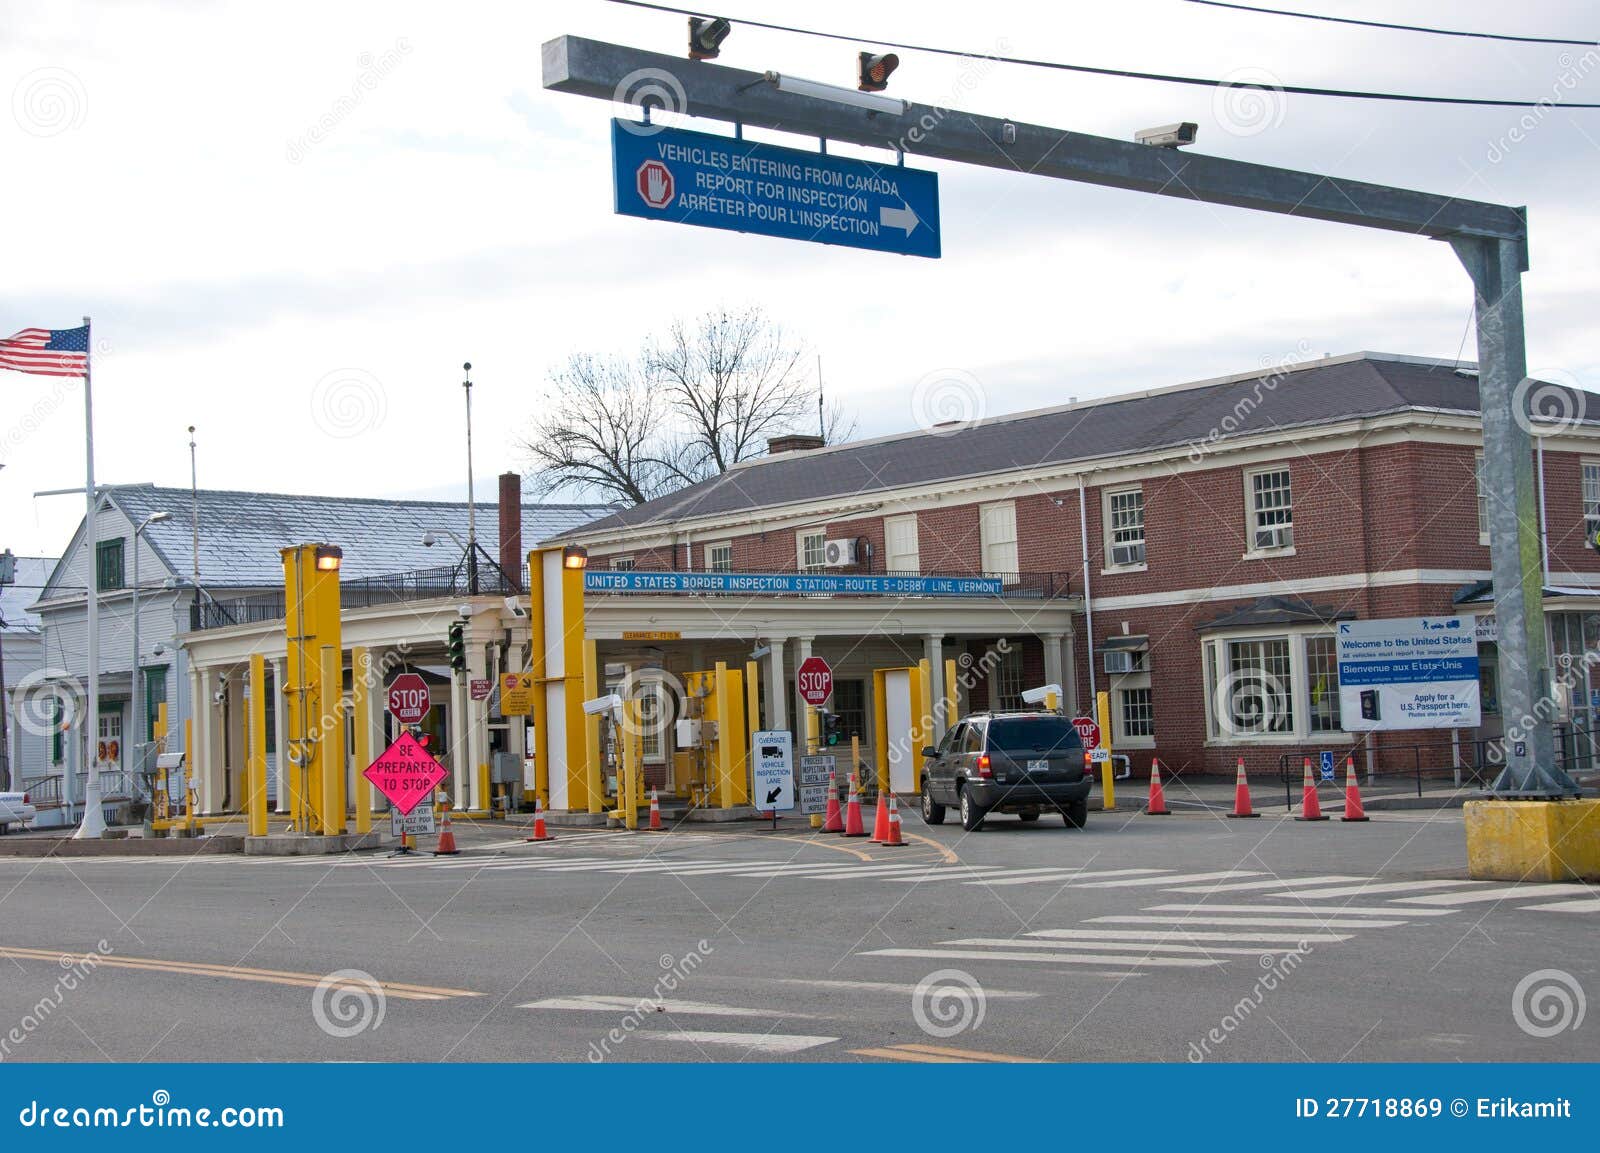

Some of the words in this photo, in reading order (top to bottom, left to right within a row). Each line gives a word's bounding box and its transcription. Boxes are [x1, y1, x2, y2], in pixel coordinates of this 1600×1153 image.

[658, 142, 729, 169] VEHICLES
[732, 155, 802, 181] ENTERING
[805, 167, 843, 188] FROM
[846, 174, 899, 196] CANADA
[696, 171, 754, 195] REPORT
[757, 182, 785, 201] FOR
[788, 186, 868, 213] INSPECTION
[748, 203, 787, 223] POUR
[790, 209, 879, 237] L'INSPECTION
[587, 575, 629, 588] UNITED
[634, 576, 677, 589] STATES
[682, 576, 724, 589] BORDER
[729, 577, 790, 590] INSPECTION
[958, 579, 1001, 593] VERMONT
[1341, 640, 1382, 649] Welcome
[1383, 639, 1393, 647] to
[1395, 638, 1410, 647] the
[1411, 636, 1440, 646] United
[1442, 635, 1473, 645] States
[1343, 664, 1391, 674] Bienvenue
[1392, 664, 1409, 672] aux
[800, 672, 830, 690] STOP
[391, 689, 427, 708] STOP
[1414, 694, 1435, 702] Apply
[1400, 703, 1416, 711] U.S.
[1417, 702, 1450, 711] Passport
[1074, 724, 1096, 736] TOP
[759, 736, 787, 744] OVERSIZE
[399, 744, 414, 757] BE
[376, 761, 436, 774] PREPARED
[756, 769, 791, 777] INSPECTION
[384, 778, 397, 791] TO
[402, 778, 431, 791] STOP
[766, 777, 782, 785] LANE
